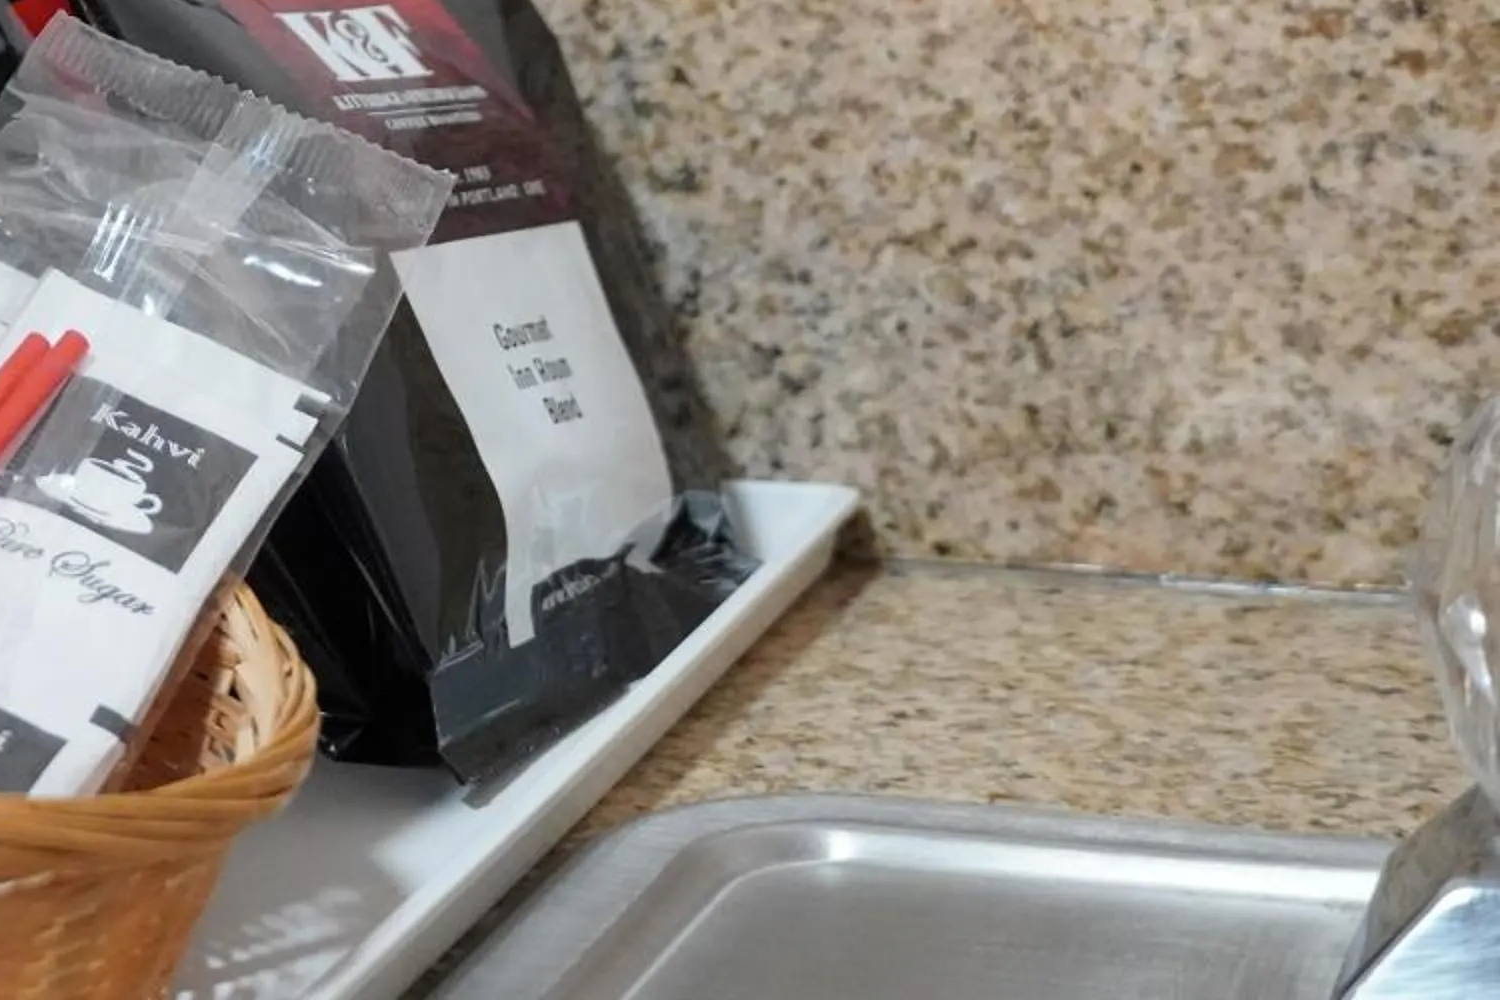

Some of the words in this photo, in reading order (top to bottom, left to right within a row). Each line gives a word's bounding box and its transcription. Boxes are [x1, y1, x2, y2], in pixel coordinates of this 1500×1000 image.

[492, 314, 553, 351] Gourmet
[542, 391, 584, 425] Blend
[89, 402, 206, 471] Kahvi
[48, 550, 157, 616] Sugar
